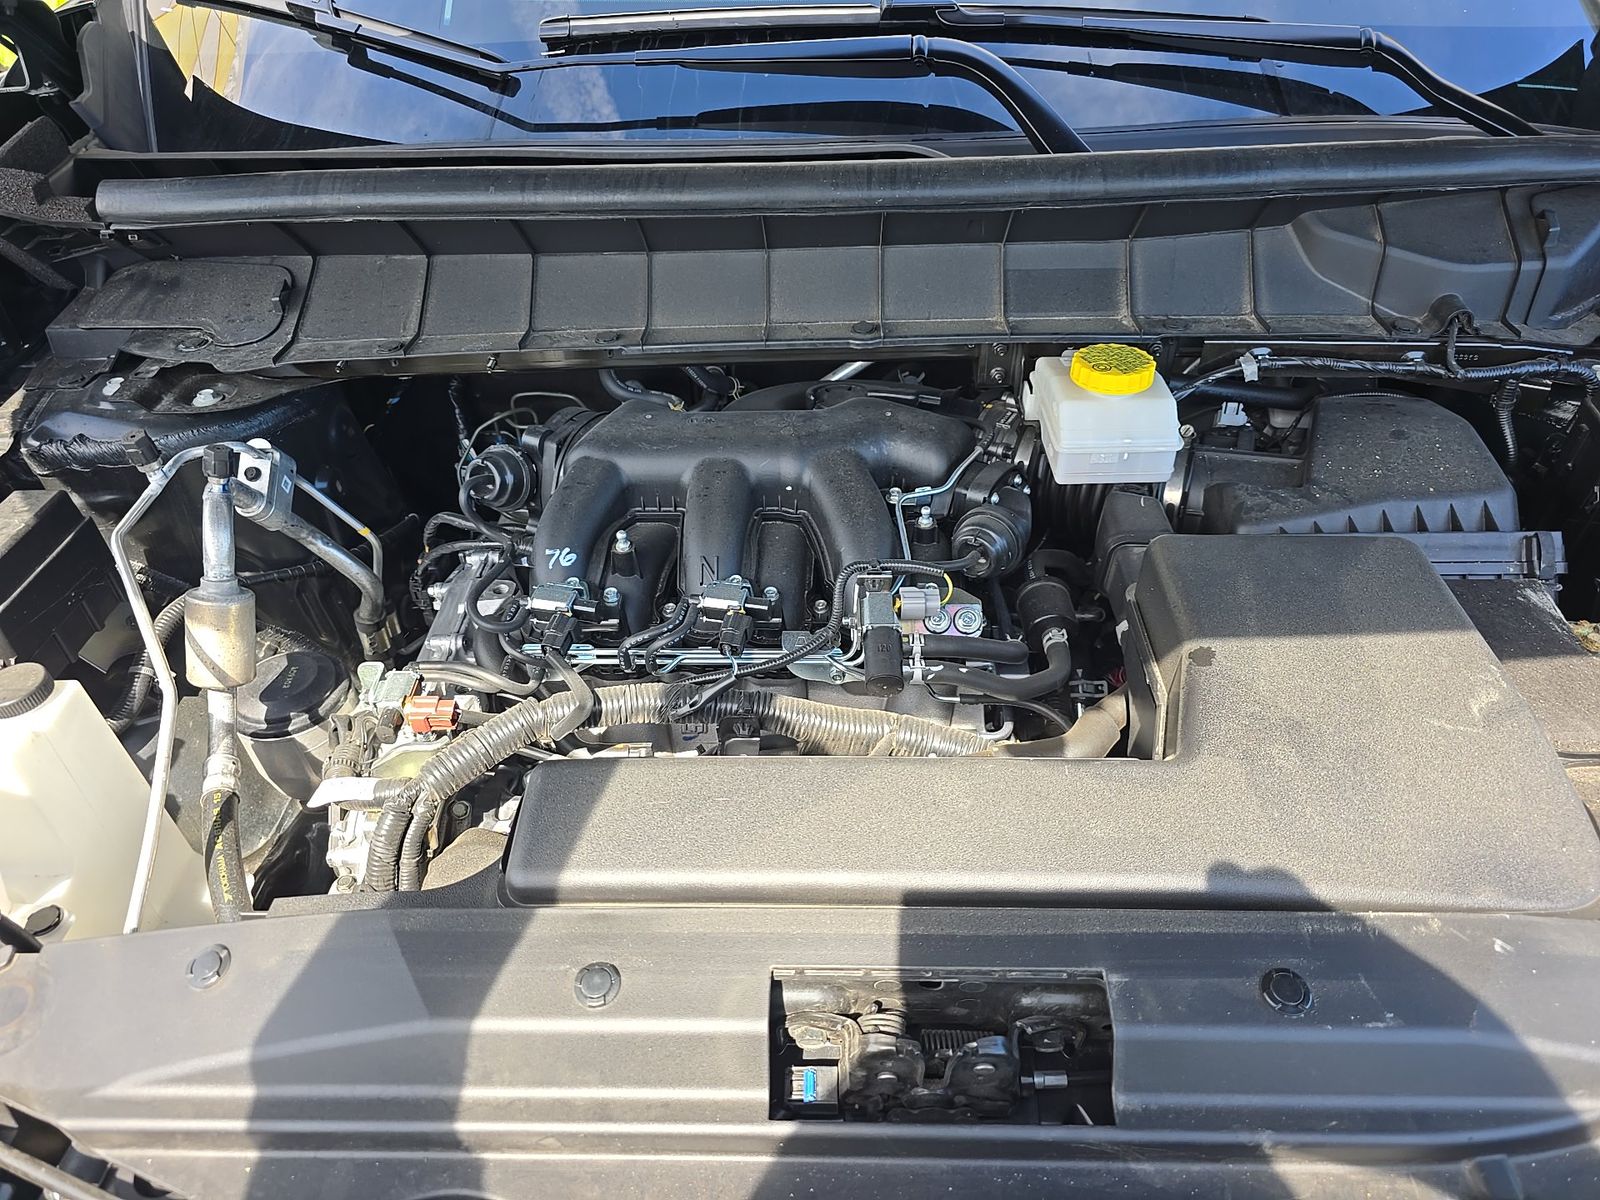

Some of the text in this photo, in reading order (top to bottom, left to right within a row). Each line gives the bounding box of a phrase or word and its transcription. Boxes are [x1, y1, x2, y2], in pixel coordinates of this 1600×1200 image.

[545, 547, 577, 570] 76
[699, 555, 719, 586] N
[213, 792, 221, 804] 15
